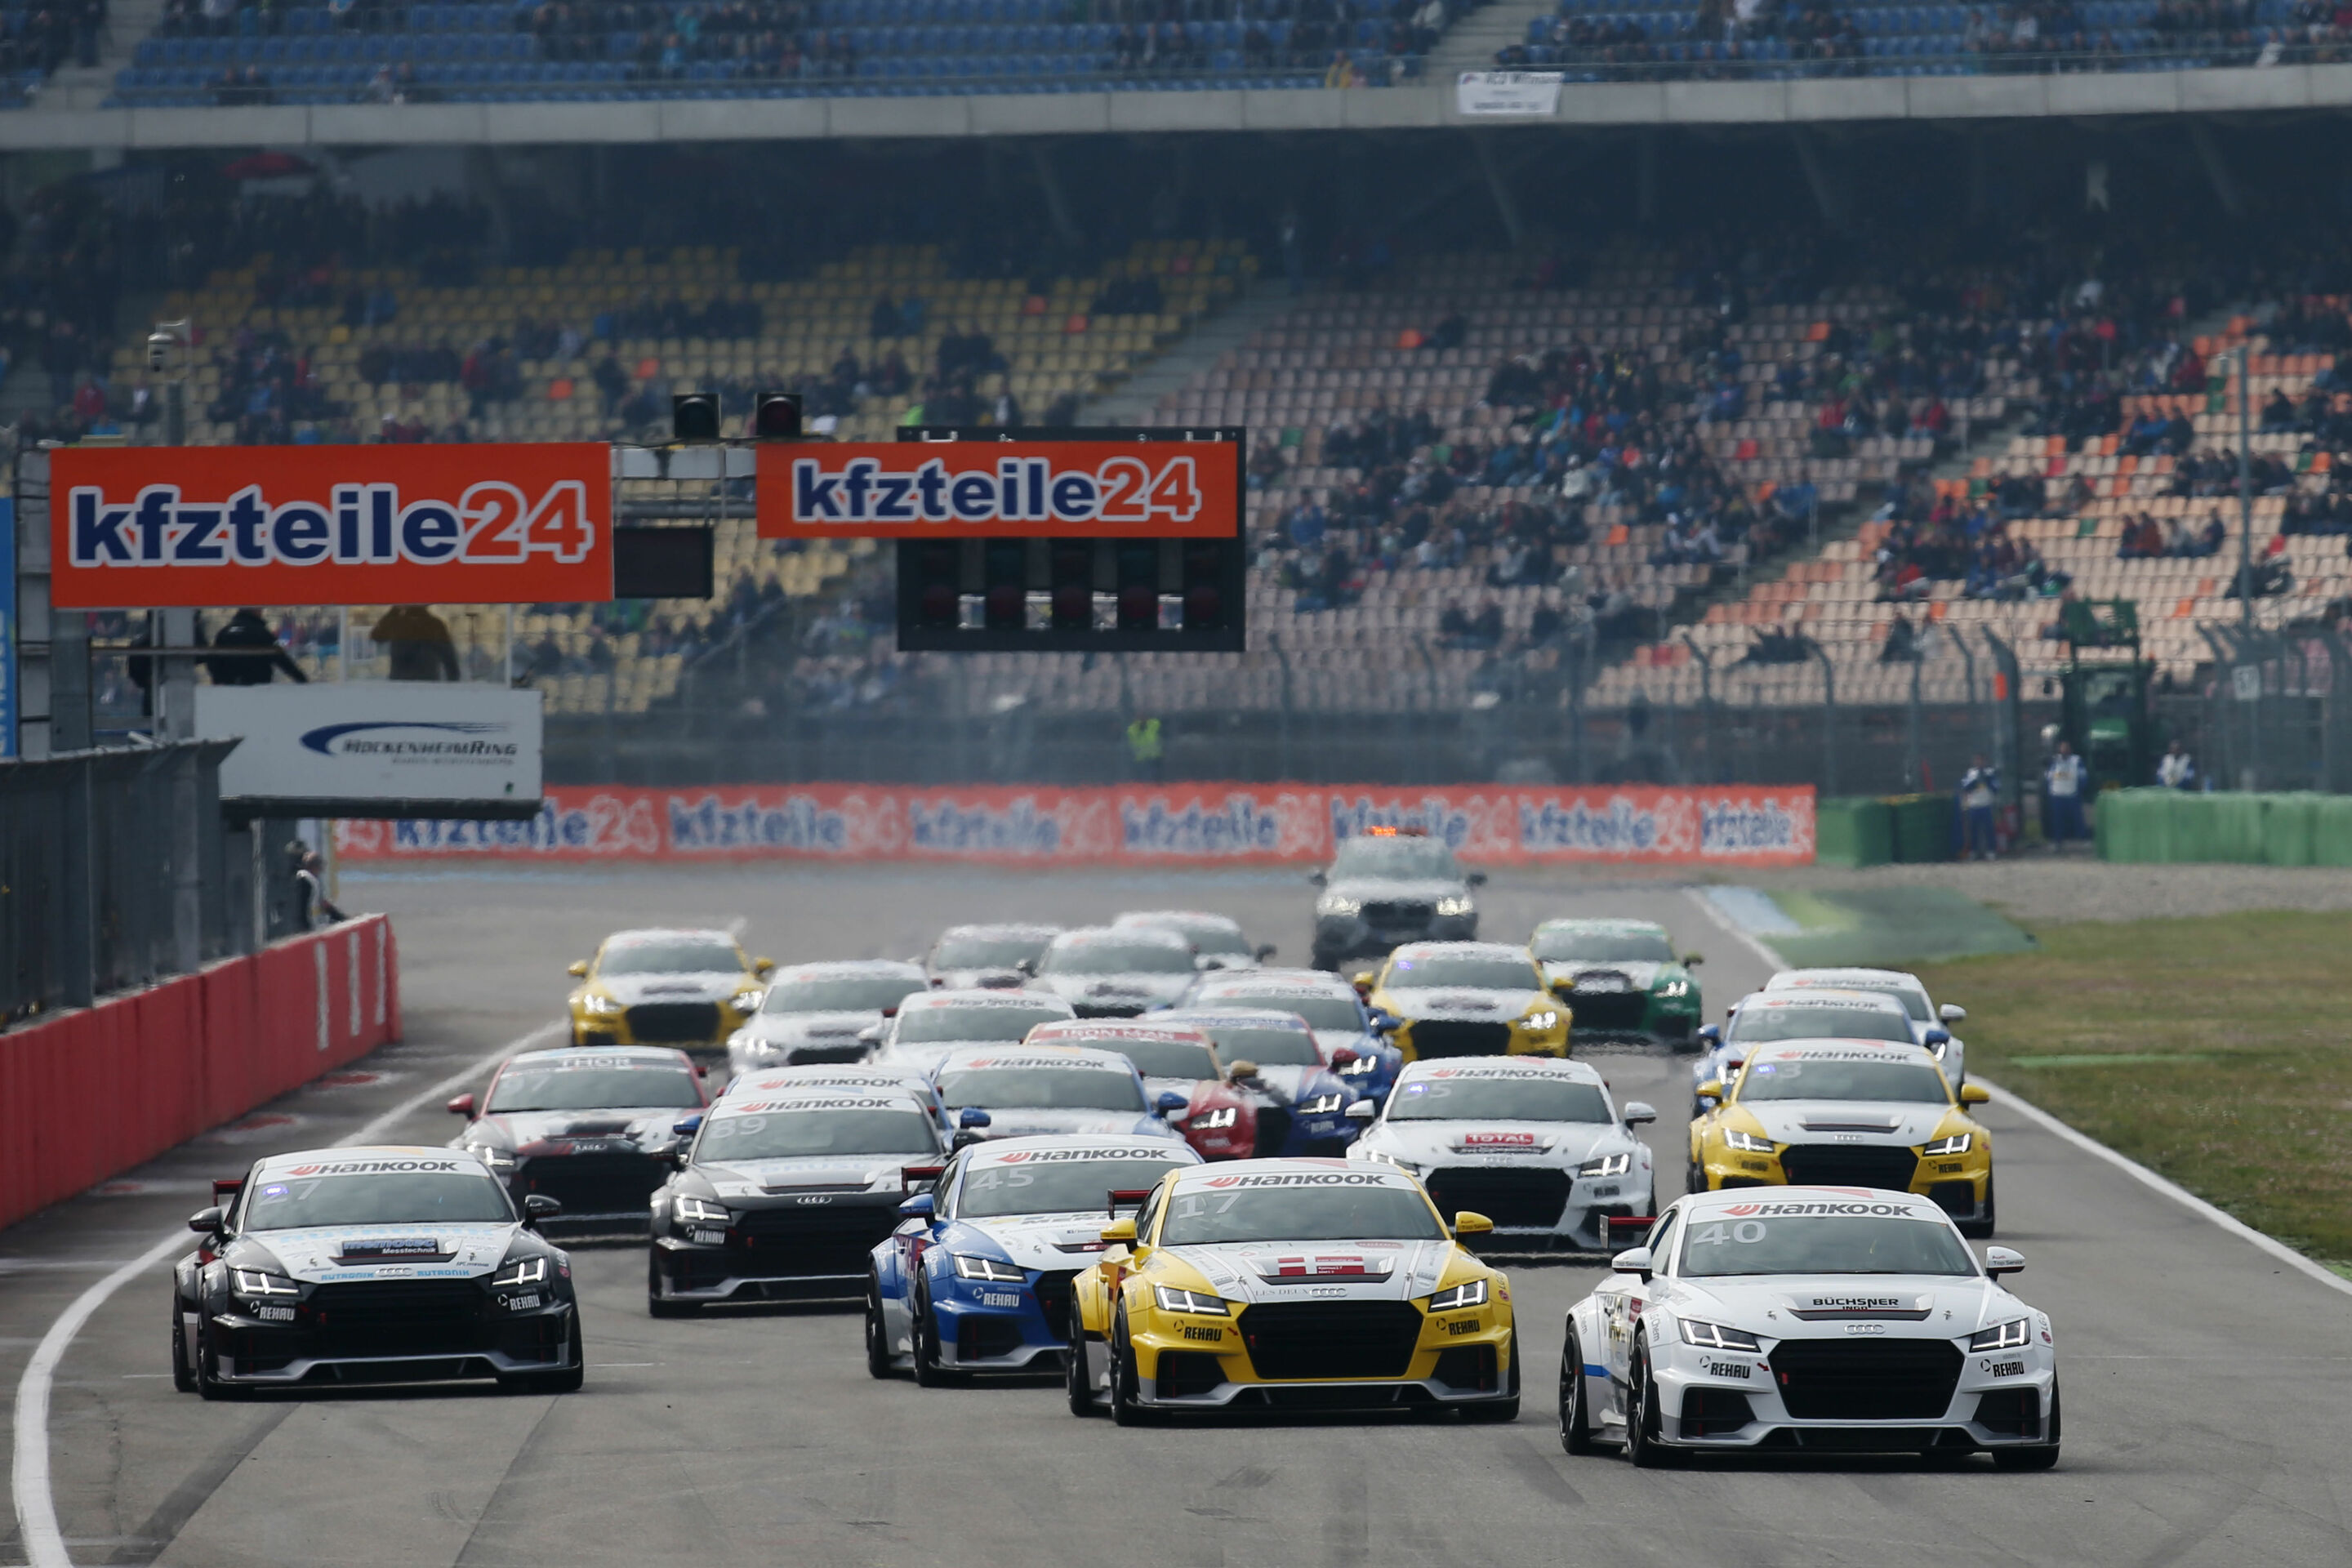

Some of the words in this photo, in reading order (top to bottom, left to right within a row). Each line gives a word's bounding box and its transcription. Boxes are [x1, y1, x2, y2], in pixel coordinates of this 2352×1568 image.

[792, 457, 1202, 523] kfzteile24
[69, 481, 594, 568] kfzteile24
[710, 1116, 767, 1138] 89
[1469, 1134, 1531, 1143] TOTAL
[970, 1167, 1034, 1190] 45
[1178, 1192, 1241, 1218] 17
[1694, 1221, 1766, 1245] 40
[510, 1294, 541, 1312] REHAU
[983, 1293, 1020, 1307] REHAU
[1813, 1297, 1899, 1307] BÜCHSNER
[260, 1306, 296, 1321] REHAU
[1184, 1326, 1223, 1341] REHAU
[1449, 1319, 1480, 1335] REHAU
[1710, 1362, 1751, 1379] REHAU
[1993, 1361, 2025, 1378] REHAU
